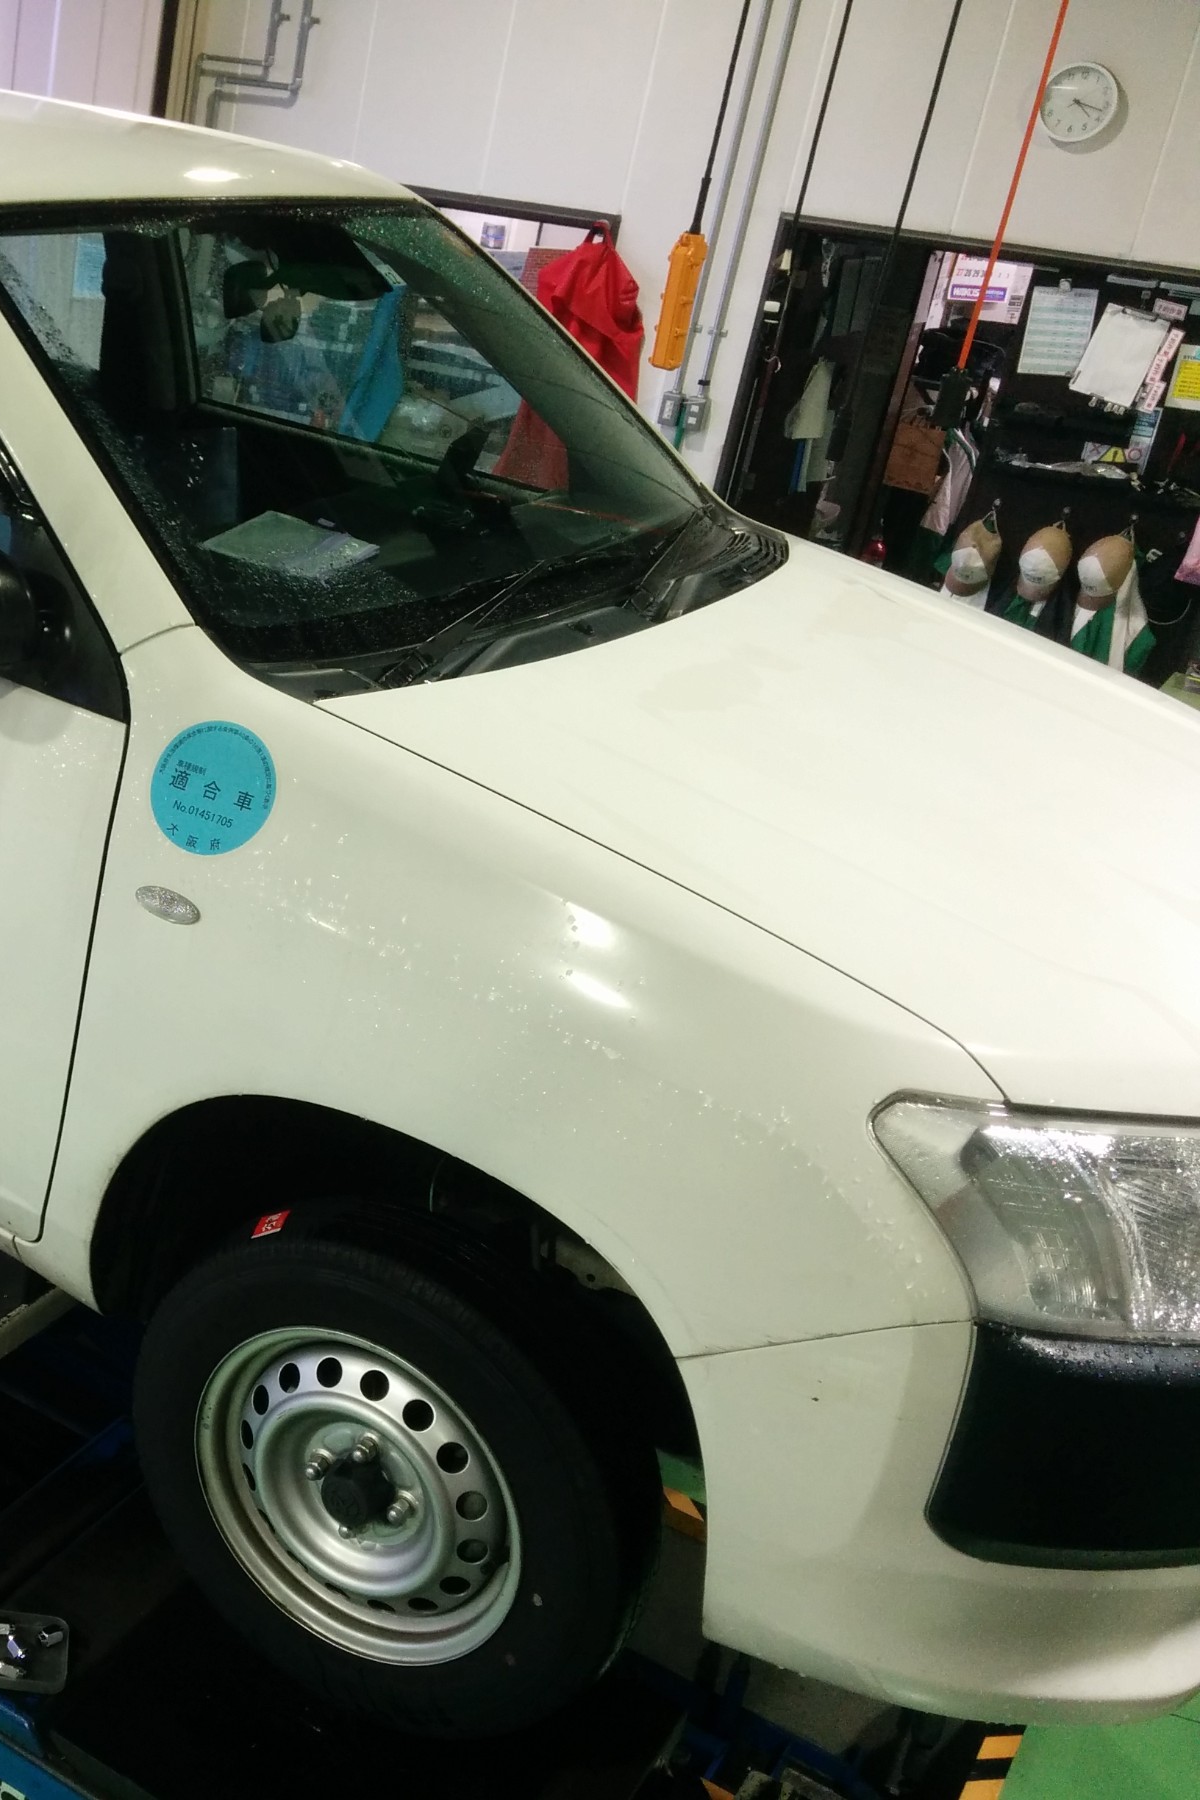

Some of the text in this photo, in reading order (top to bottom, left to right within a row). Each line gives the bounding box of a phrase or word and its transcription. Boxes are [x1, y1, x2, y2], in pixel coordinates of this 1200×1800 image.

[176, 759, 207, 776] 車種規制
[168, 768, 255, 811] 適合車
[172, 800, 234, 829] No.01451705
[166, 823, 222, 851] 大阪府
